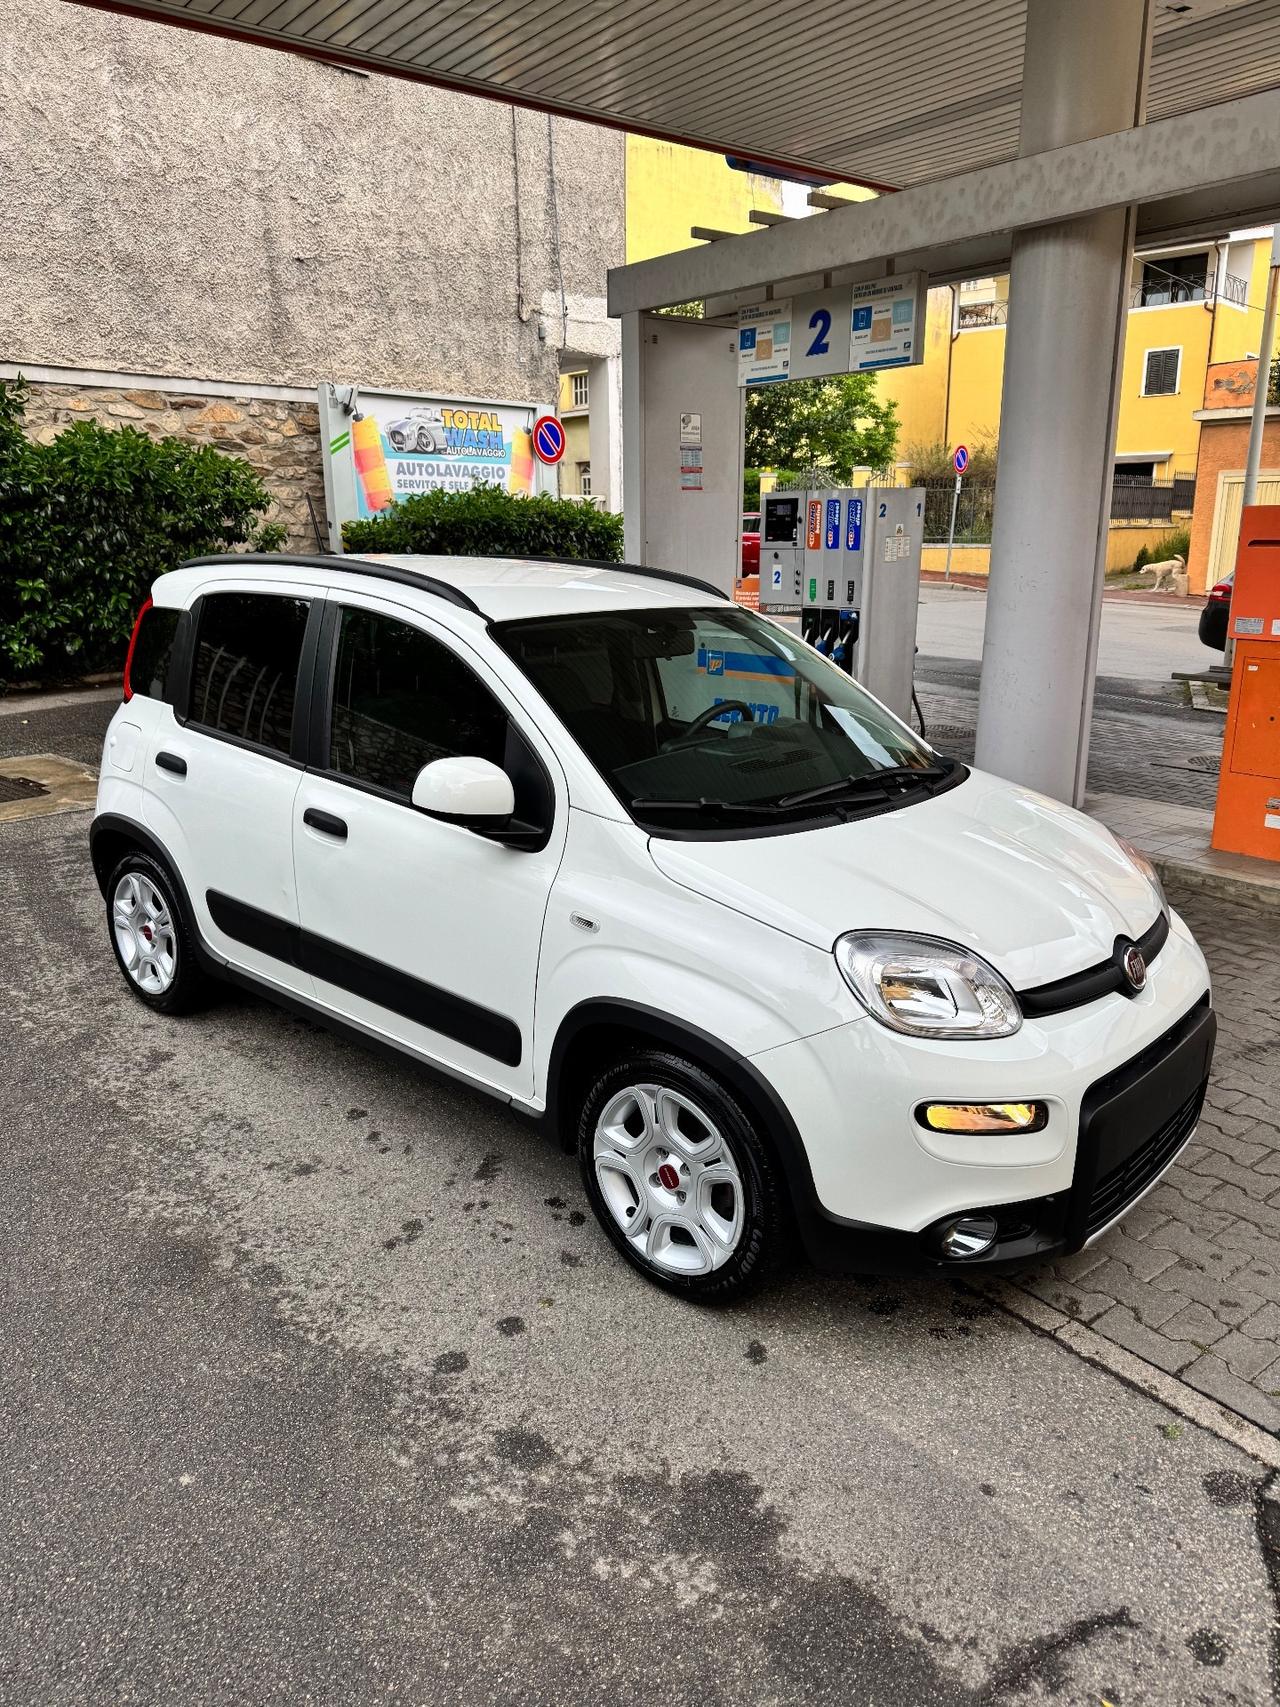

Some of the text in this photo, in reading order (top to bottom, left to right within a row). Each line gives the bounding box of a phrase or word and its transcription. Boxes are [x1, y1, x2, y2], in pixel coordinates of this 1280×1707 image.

[805, 308, 832, 357] 2
[441, 408, 503, 432] TOTAL
[443, 428, 504, 450] WASH
[446, 446, 506, 458] AUTOLAVAGGIO
[396, 462, 506, 480] AUTOLAVAGGIO
[397, 479, 437, 490] SERVITO
[441, 480, 446, 489] E
[449, 480, 469, 490] SELF
[878, 503, 887, 518] 2
[916, 503, 921, 517] 1
[773, 570, 781, 584] 2
